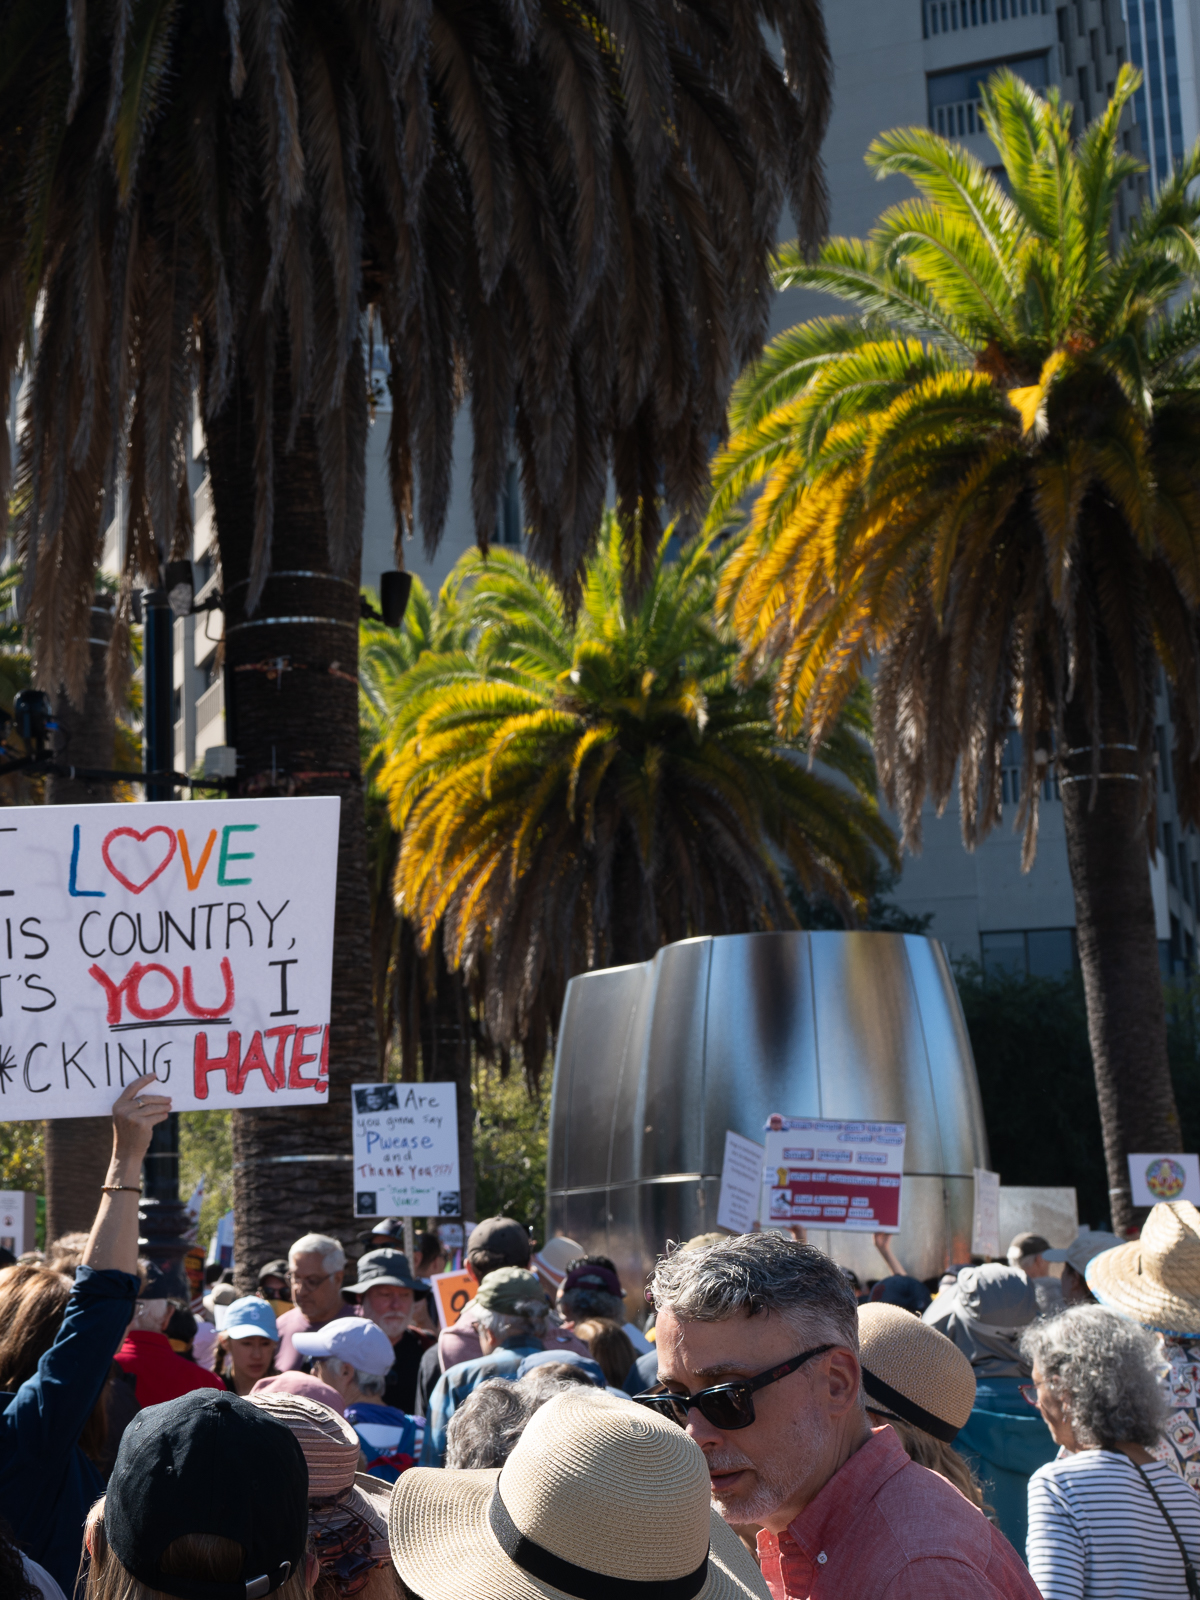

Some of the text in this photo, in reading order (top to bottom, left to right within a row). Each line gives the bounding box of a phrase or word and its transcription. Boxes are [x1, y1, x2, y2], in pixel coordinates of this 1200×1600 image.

[79, 899, 296, 958] COUNTRY,
[88, 956, 235, 1025] YOU
[268, 958, 300, 1017] I
[193, 1023, 330, 1099] HATE!
[404, 1088, 440, 1110] Are
[356, 1114, 443, 1138] you gonna say
[366, 1130, 434, 1154] Pwease
[383, 1150, 413, 1162] and
[357, 1163, 405, 1178] Thank
